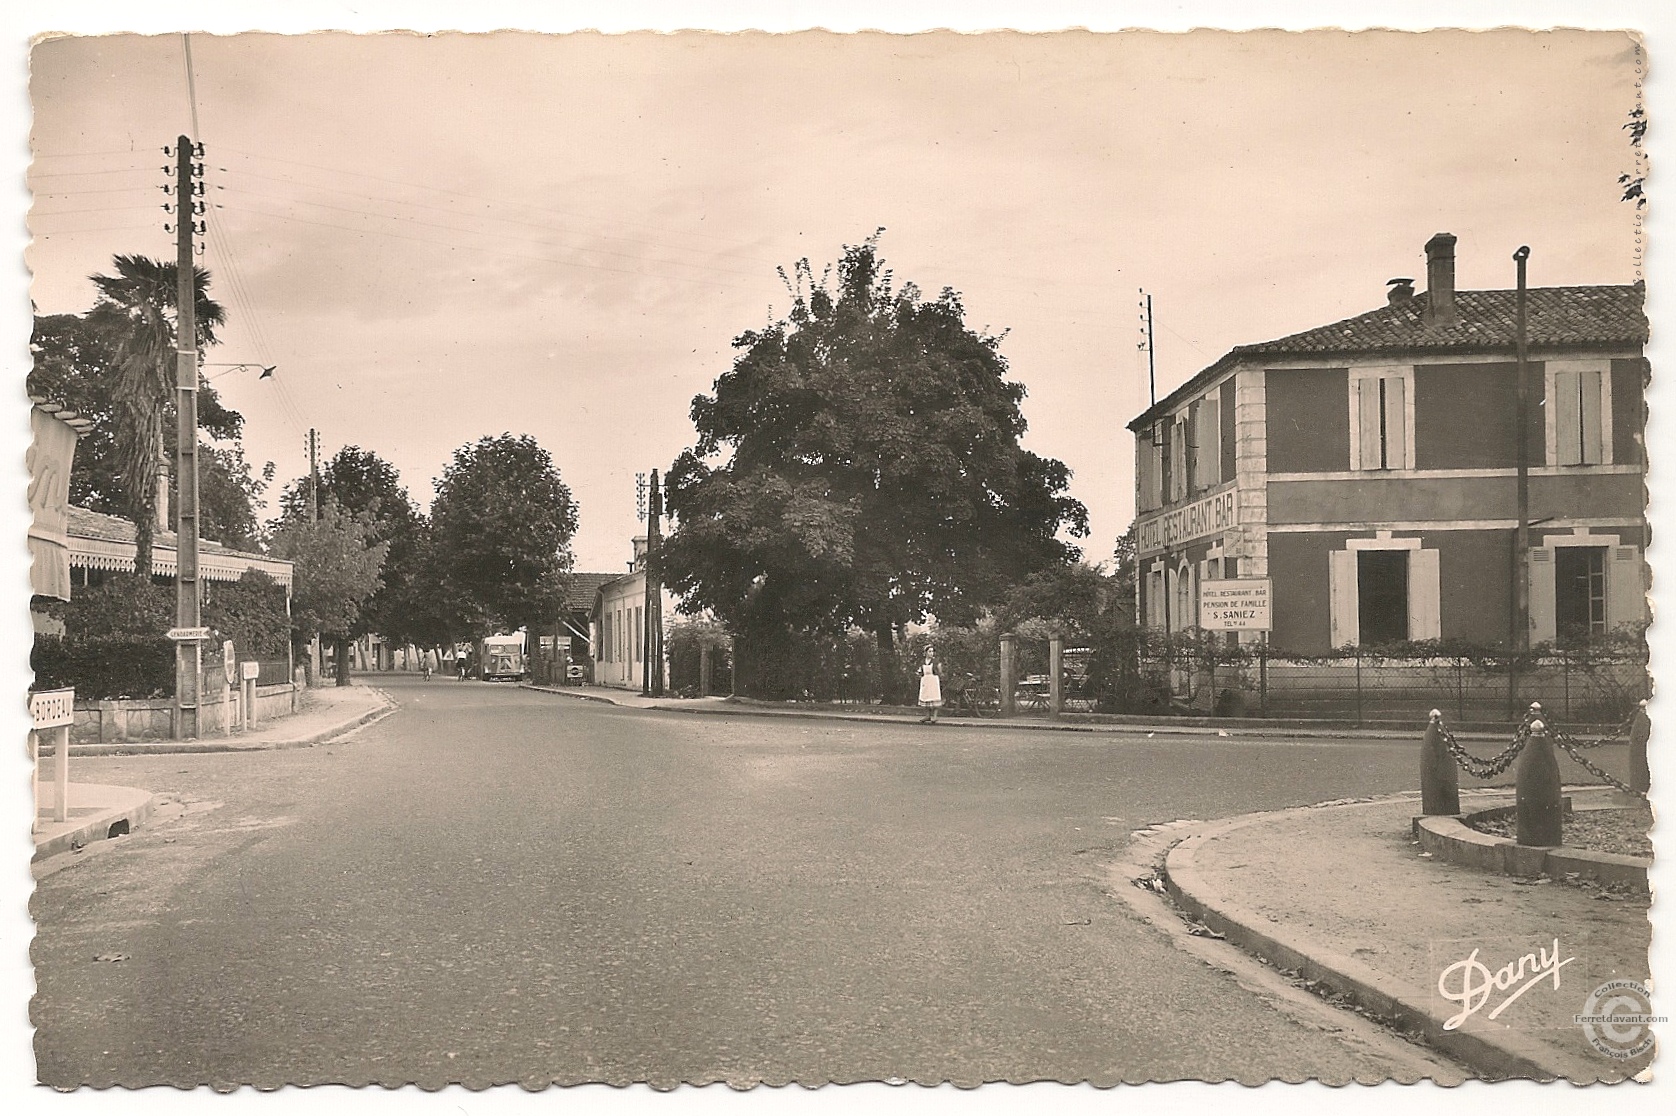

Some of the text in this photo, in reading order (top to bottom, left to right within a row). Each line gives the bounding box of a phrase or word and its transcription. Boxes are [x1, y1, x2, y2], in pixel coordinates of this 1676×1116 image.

[1215, 493, 1233, 528] BAR
[1230, 600, 1239, 608] DE
[1241, 599, 1267, 608] FAMILLE
